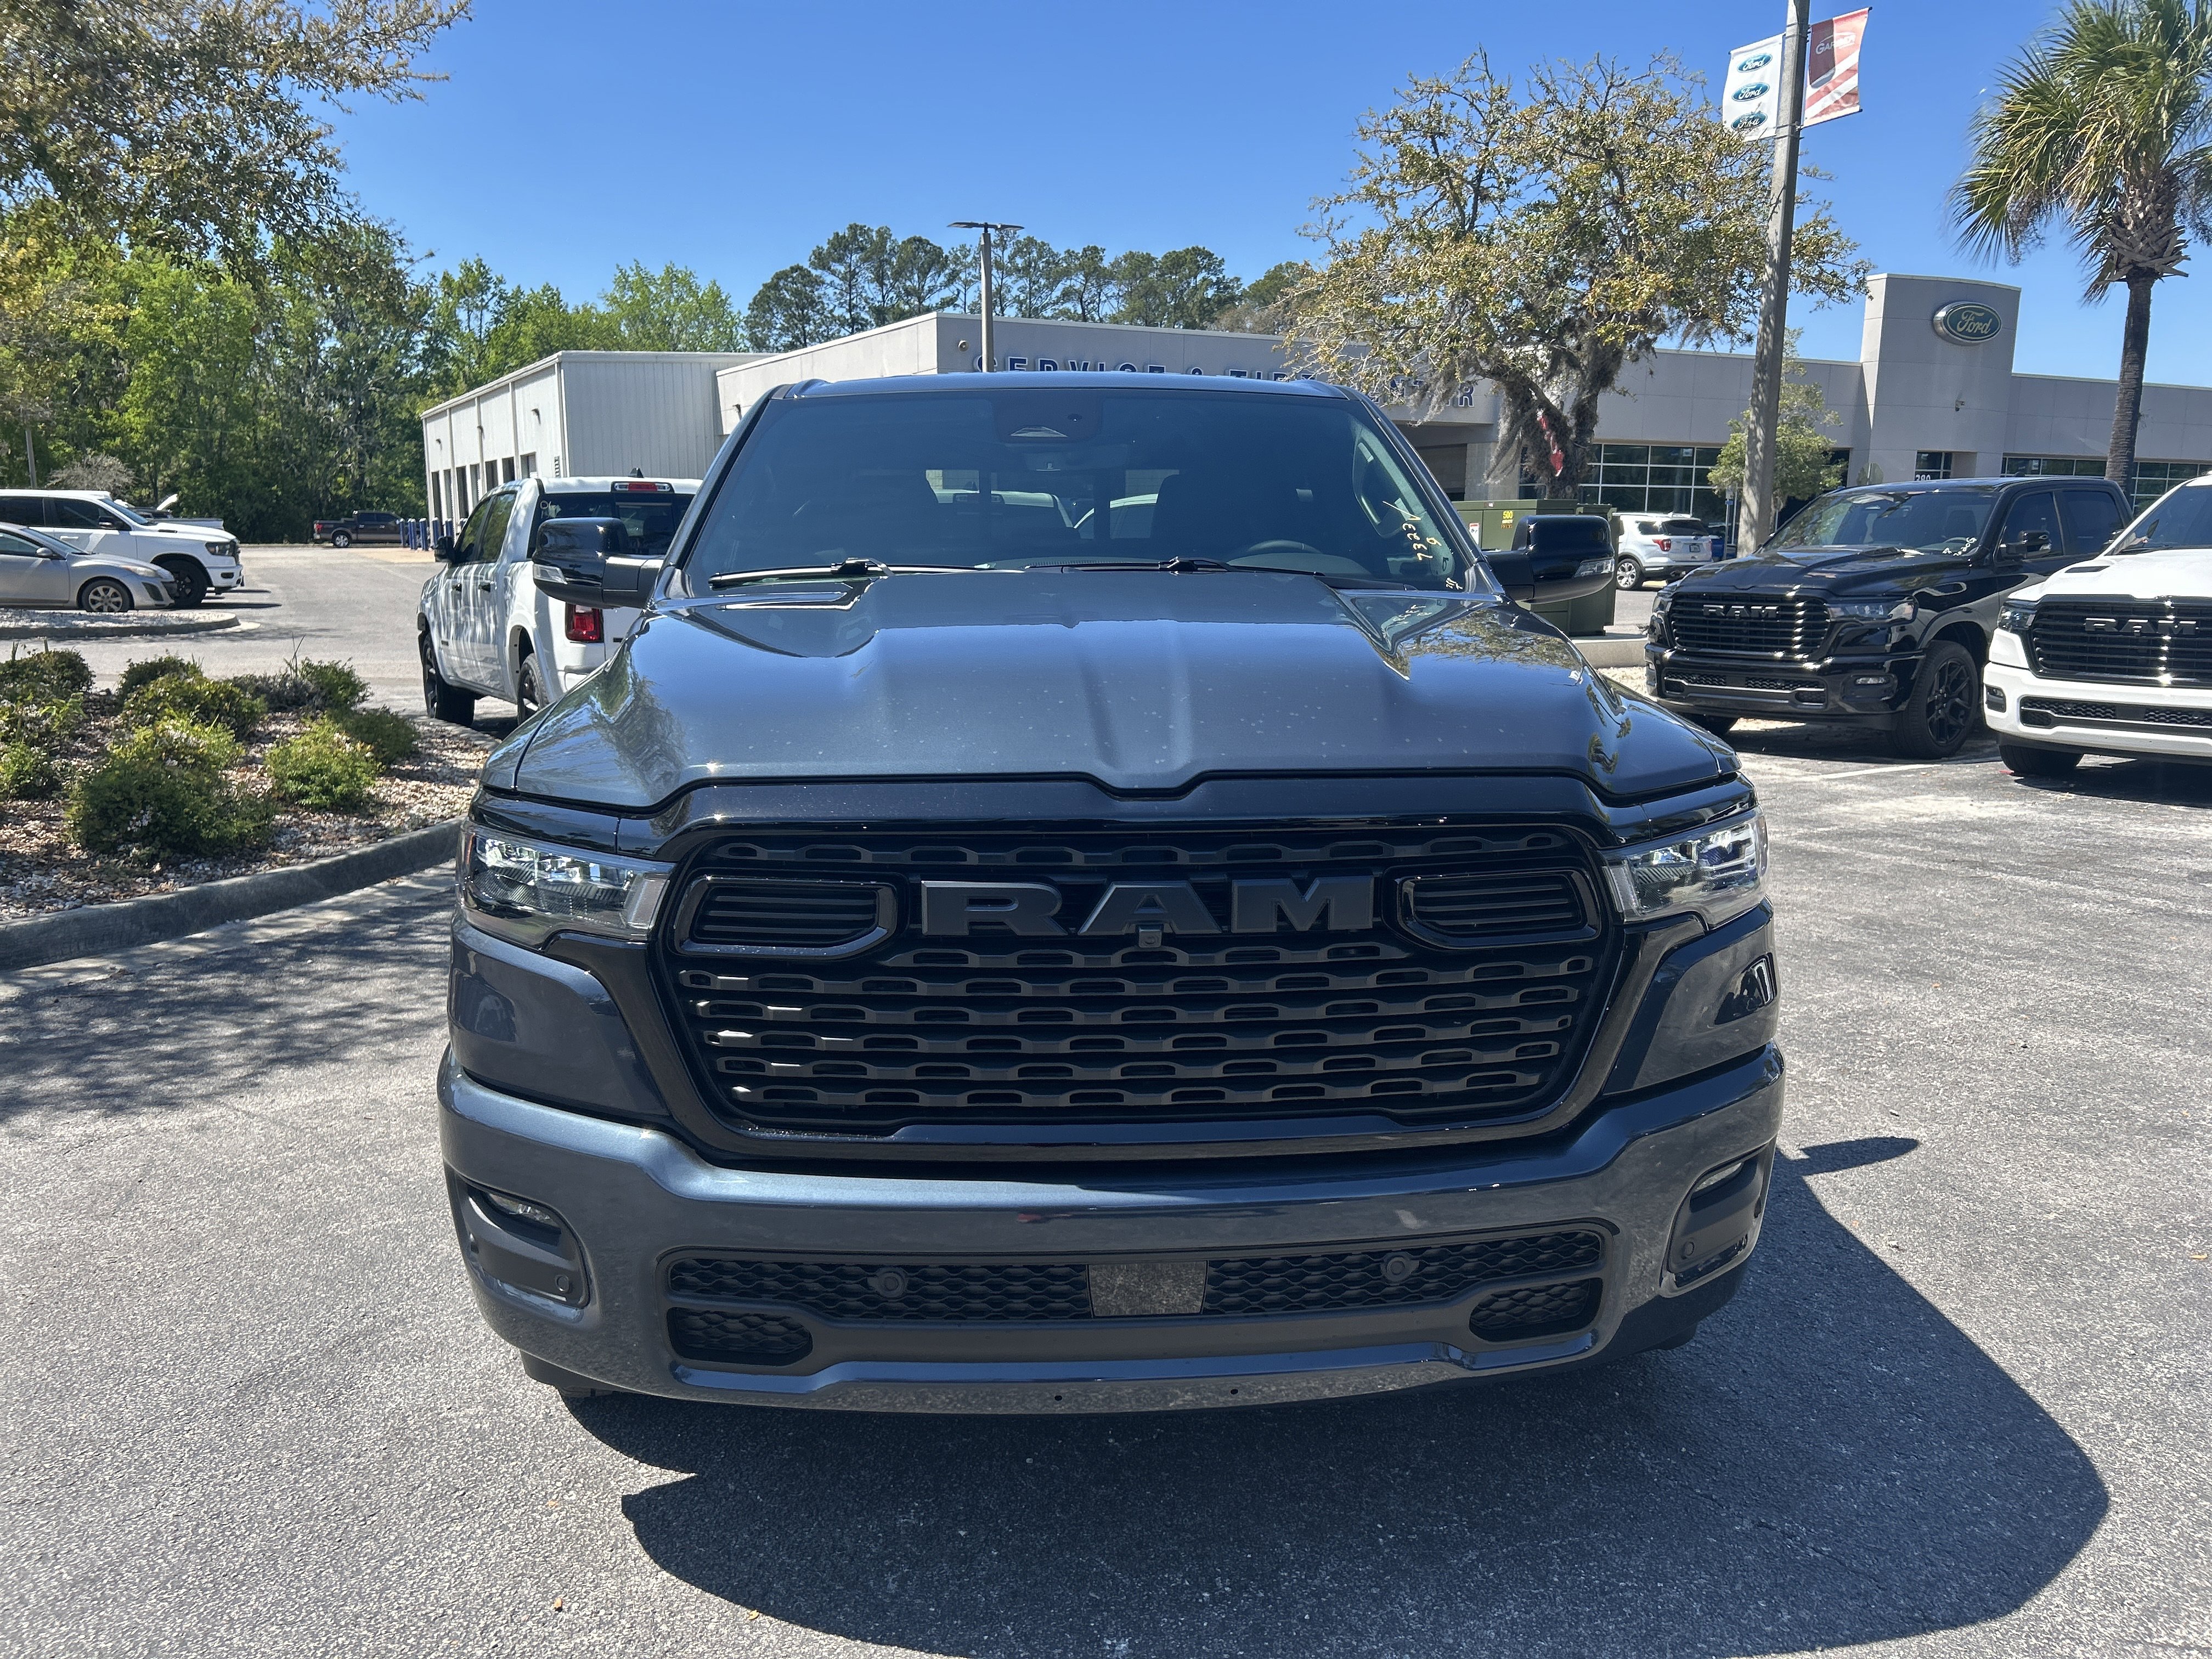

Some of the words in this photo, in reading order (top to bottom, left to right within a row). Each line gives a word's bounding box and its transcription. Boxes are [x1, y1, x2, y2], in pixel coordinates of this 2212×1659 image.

[1742, 56, 1766, 71] Ford
[1738, 84, 1763, 100] Ford
[1956, 310, 1993, 334] Ford
[1703, 605, 1778, 618] RAM
[2085, 618, 2198, 635] RAM
[921, 878, 1375, 936] RAM
